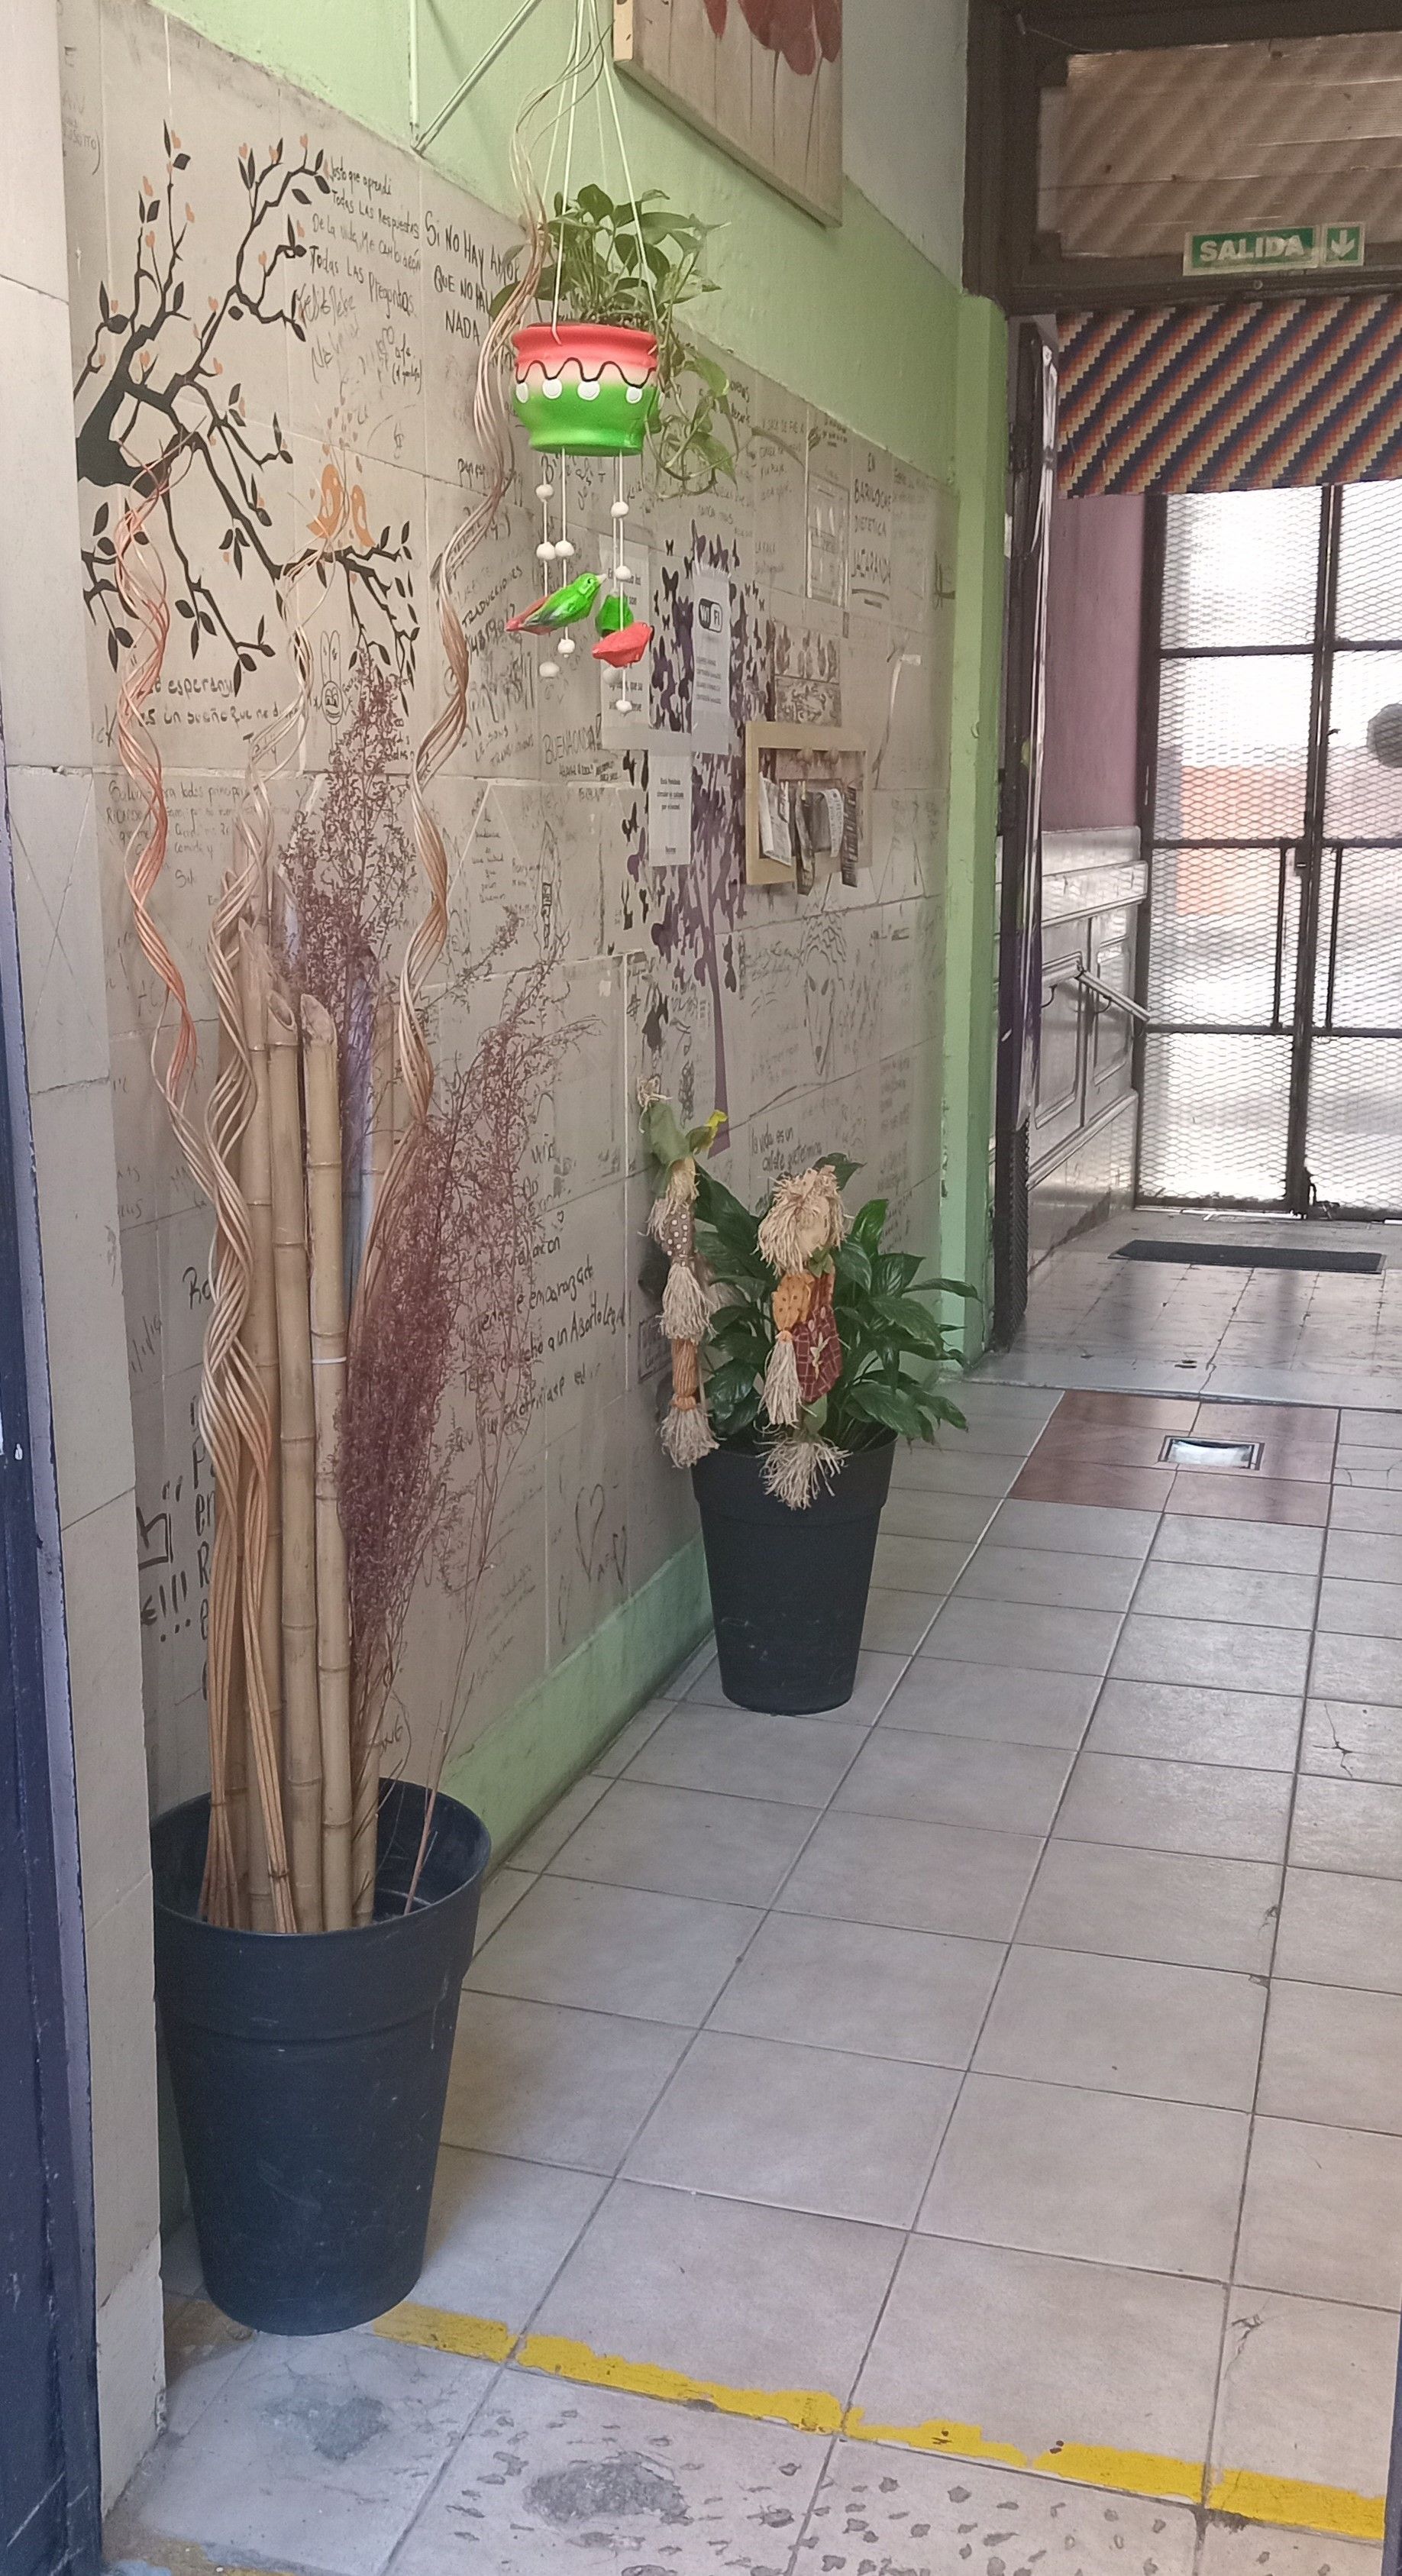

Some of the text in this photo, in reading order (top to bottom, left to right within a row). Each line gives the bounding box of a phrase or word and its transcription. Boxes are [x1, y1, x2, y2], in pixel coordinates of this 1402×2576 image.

[445, 225, 460, 253] NO
[464, 230, 486, 291] HAY
[1200, 234, 1304, 261] SALIDA
[460, 278, 473, 301] NO
[445, 309, 481, 347] NADA
